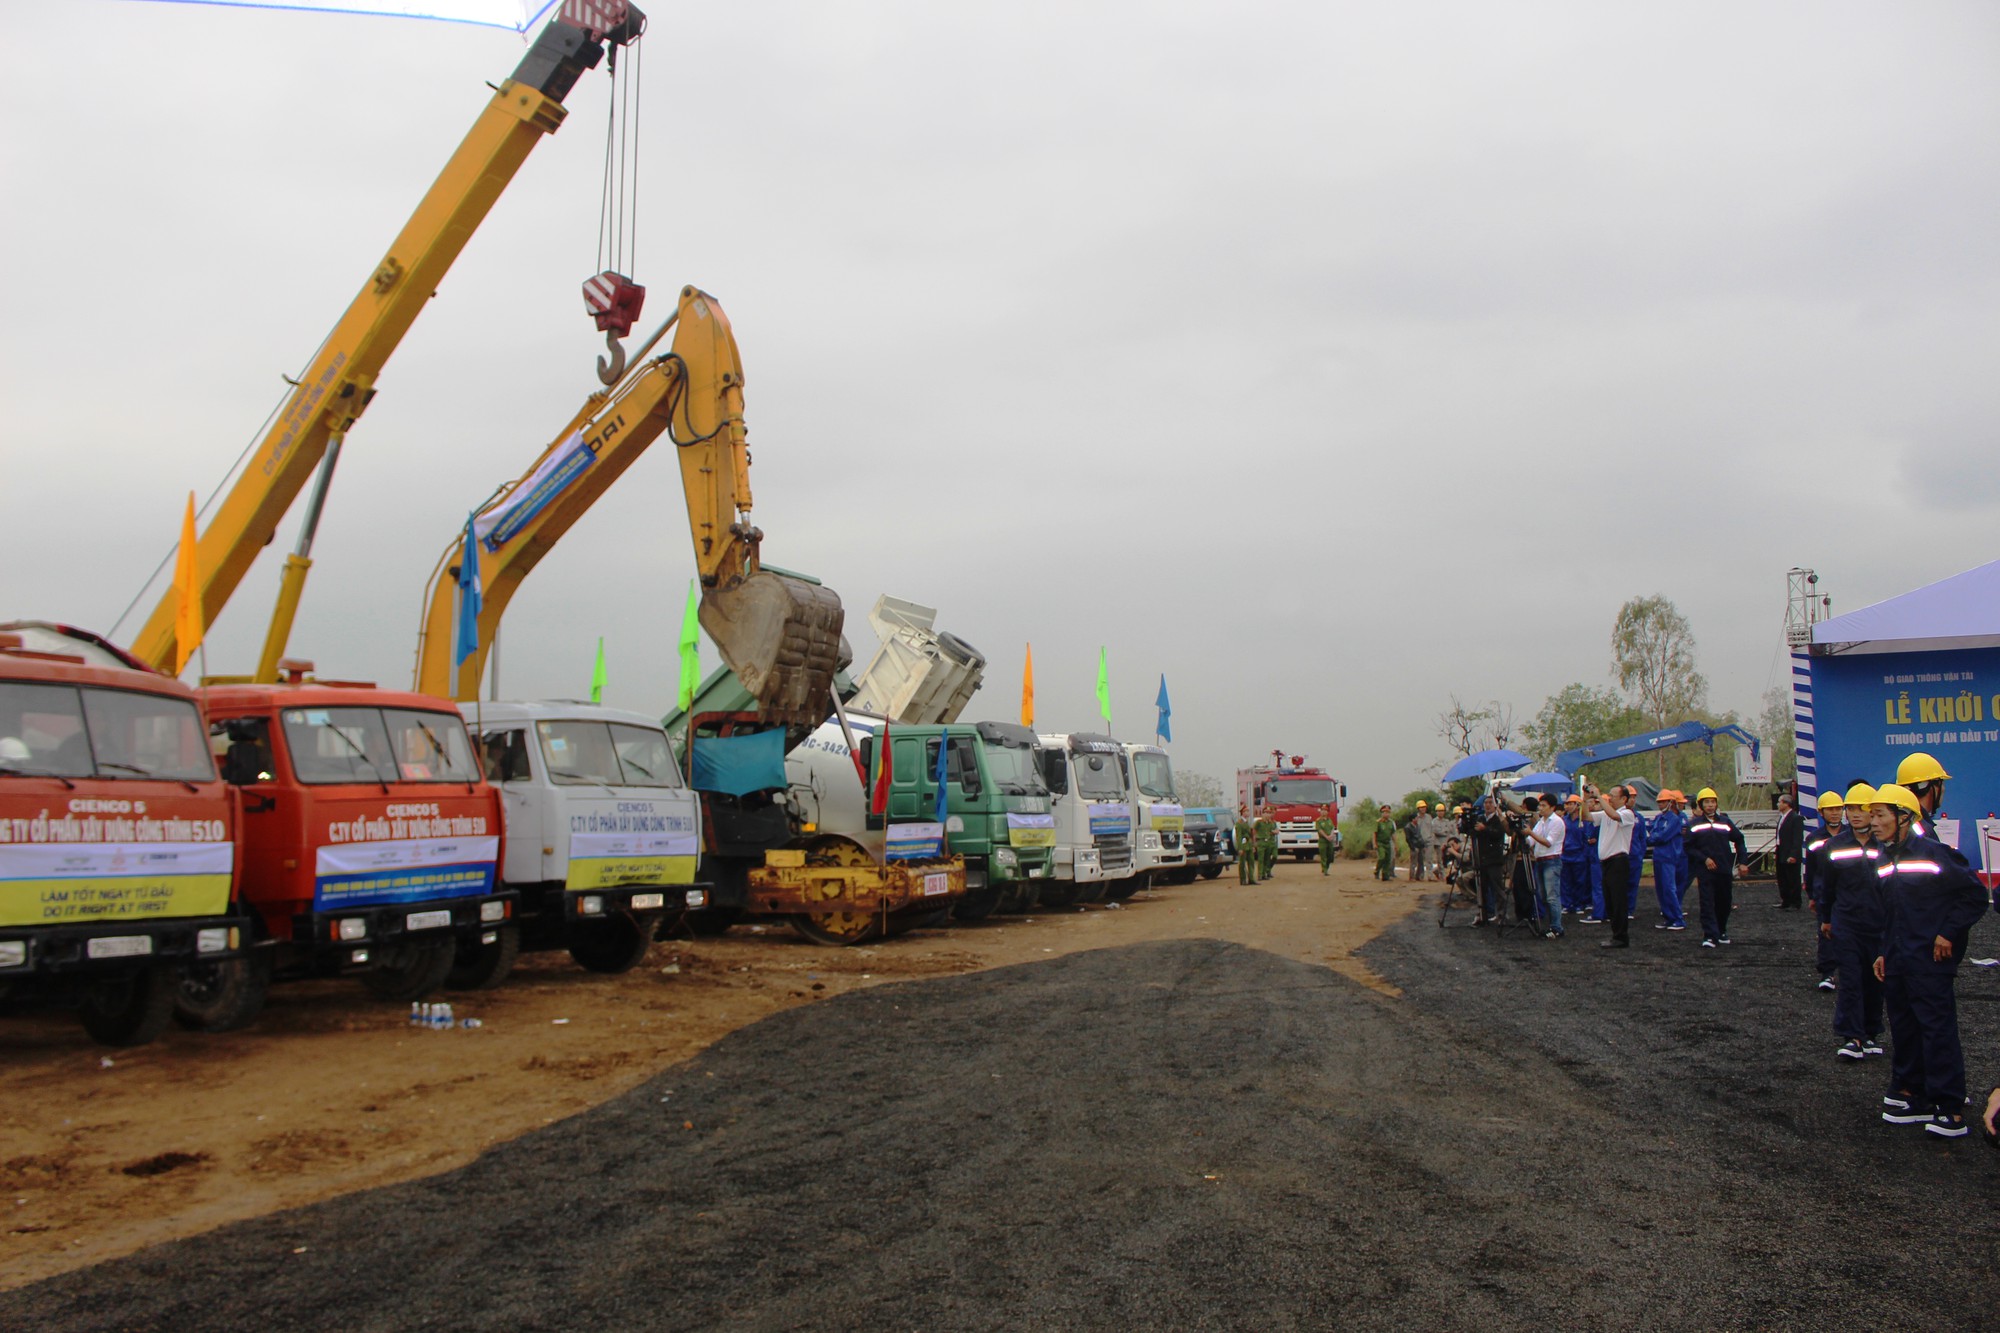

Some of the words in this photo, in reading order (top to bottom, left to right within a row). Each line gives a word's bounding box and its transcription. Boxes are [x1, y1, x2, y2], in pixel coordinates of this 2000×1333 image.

[1884, 675, 1895, 685] BỘ
[1896, 674, 1915, 684] GIAO
[1916, 673, 1941, 683] THÔNG
[1943, 672, 1959, 683] VẬN
[1885, 691, 1912, 725] LỄ
[1919, 690, 1983, 724] KHỞI
[1926, 730, 1941, 746] DỰ
[1943, 730, 1957, 744] ÁN
[1960, 728, 1982, 743] ĐẦU
[1984, 728, 1999, 742] TƯ
[68, 799, 131, 814] CIENCO
[133, 800, 147, 815] 5
[386, 804, 430, 818] CIENCO
[430, 803, 440, 816] 5
[617, 802, 648, 813] CIENCO
[649, 802, 655, 813] 5
[12, 818, 29, 843] TY
[192, 819, 226, 842] 510
[473, 816, 487, 835] 510
[683, 816, 693, 832] 510
[99, 887, 132, 900] NGAY
[43, 905, 62, 918] DO
[64, 904, 76, 916] IT
[79, 903, 116, 915] RIGHT
[118, 902, 135, 913] AT
